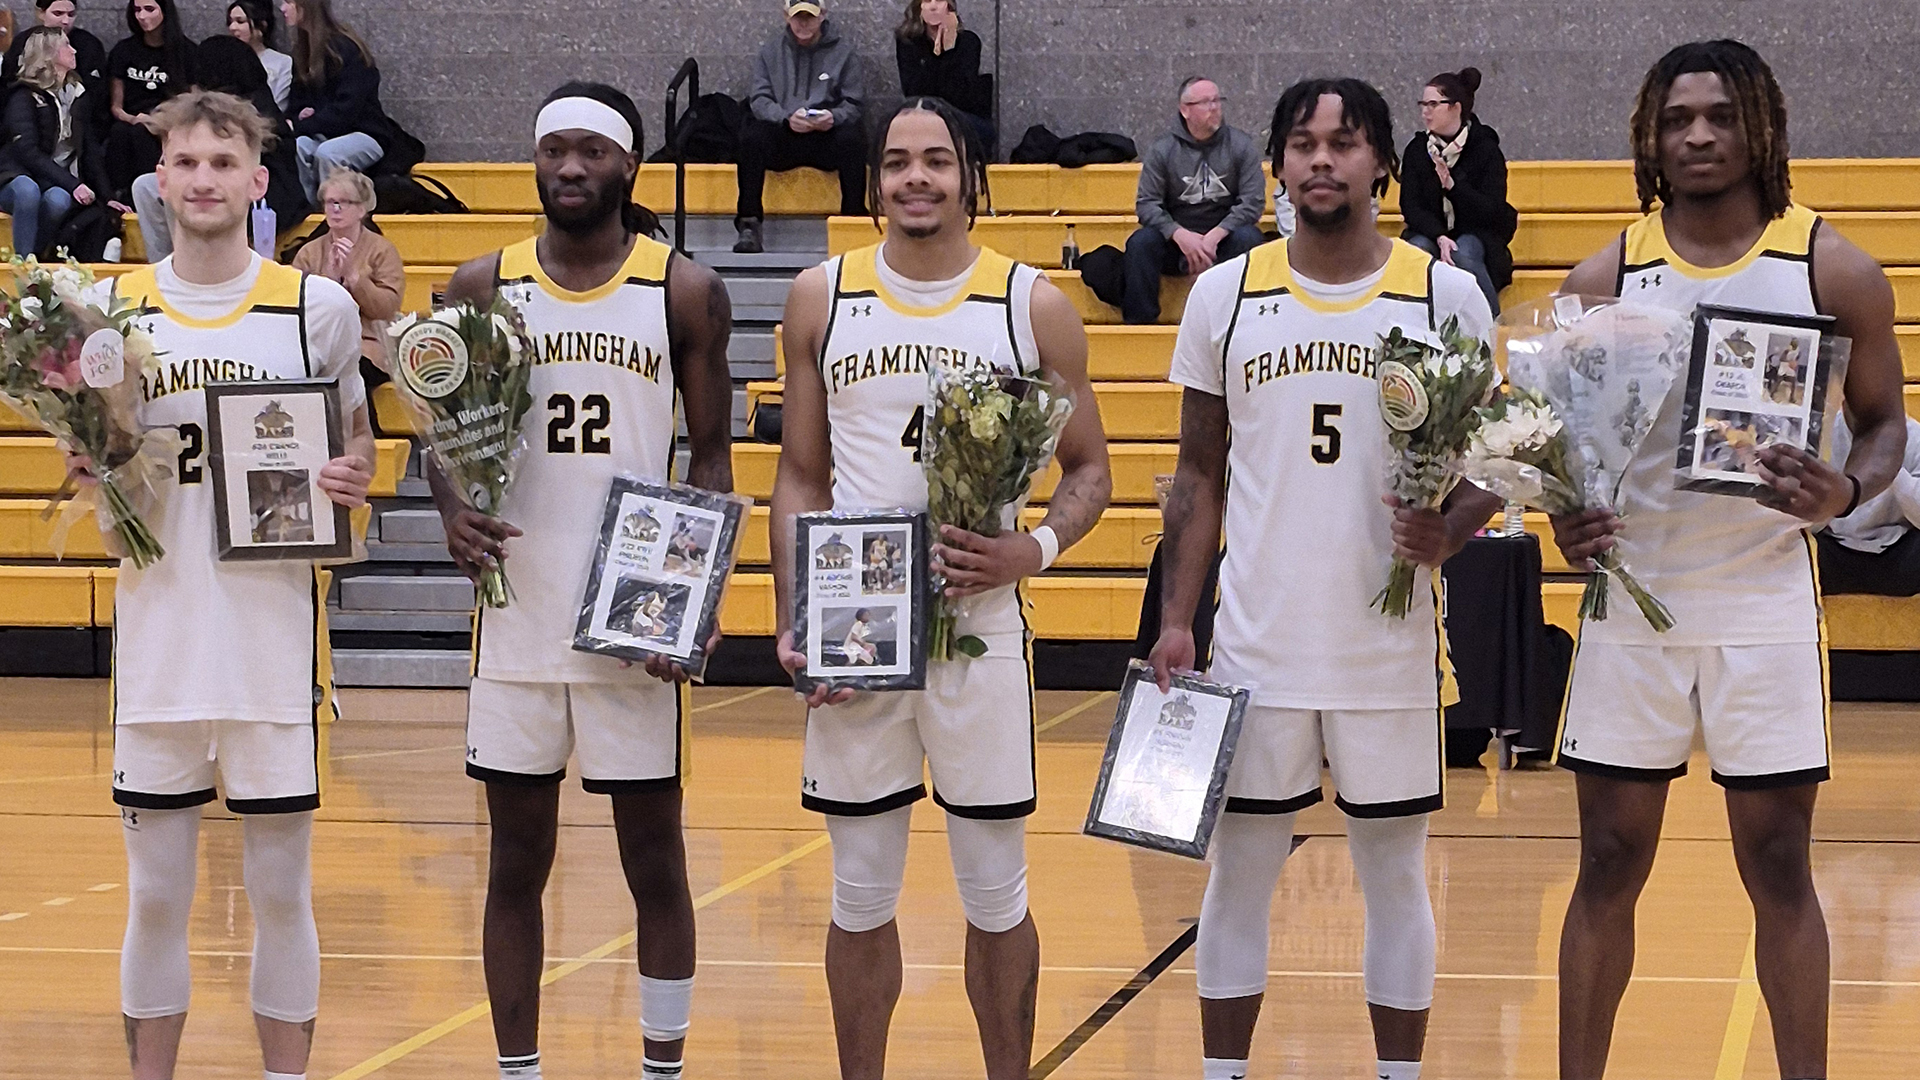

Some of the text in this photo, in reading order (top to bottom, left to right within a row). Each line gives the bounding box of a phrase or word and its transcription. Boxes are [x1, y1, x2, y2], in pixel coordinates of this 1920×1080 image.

[138, 358, 283, 403] RAMINGH
[830, 344, 1000, 395] FRAMINGH
[547, 394, 611, 454] 22
[901, 404, 925, 463] 4
[1311, 403, 1343, 465] 5
